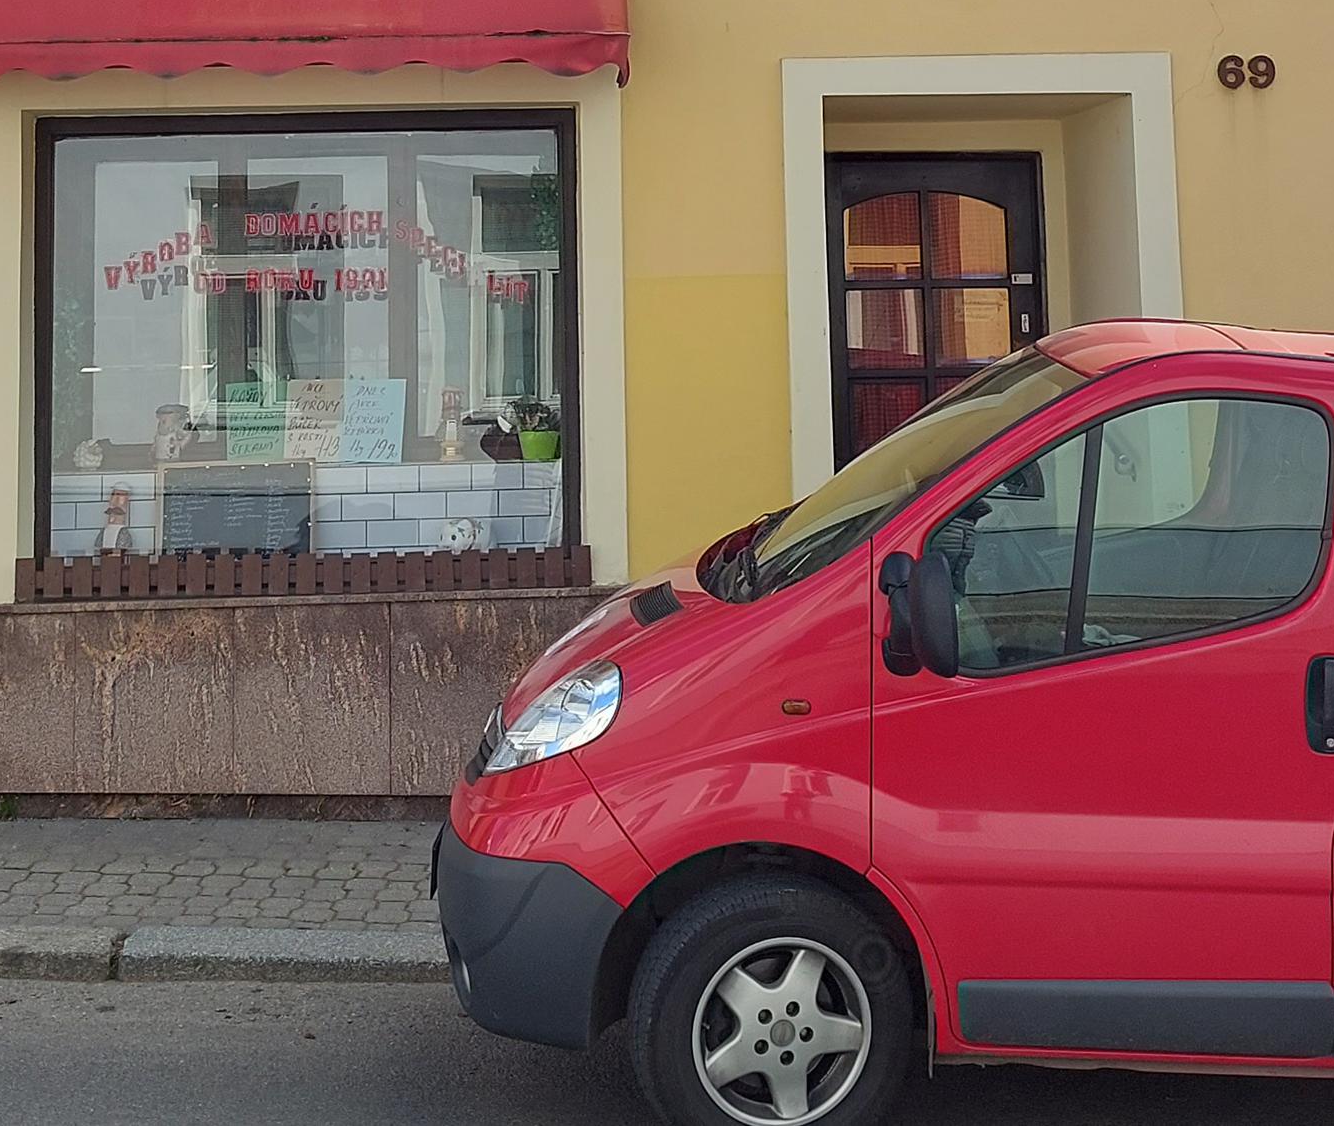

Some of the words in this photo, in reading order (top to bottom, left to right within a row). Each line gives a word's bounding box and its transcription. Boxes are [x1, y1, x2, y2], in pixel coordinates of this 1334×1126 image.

[1217, 55, 1276, 89] 69
[104, 222, 214, 291] VÝROBA
[244, 202, 384, 236] DOMÁCÍCH
[244, 268, 315, 293] ROKU
